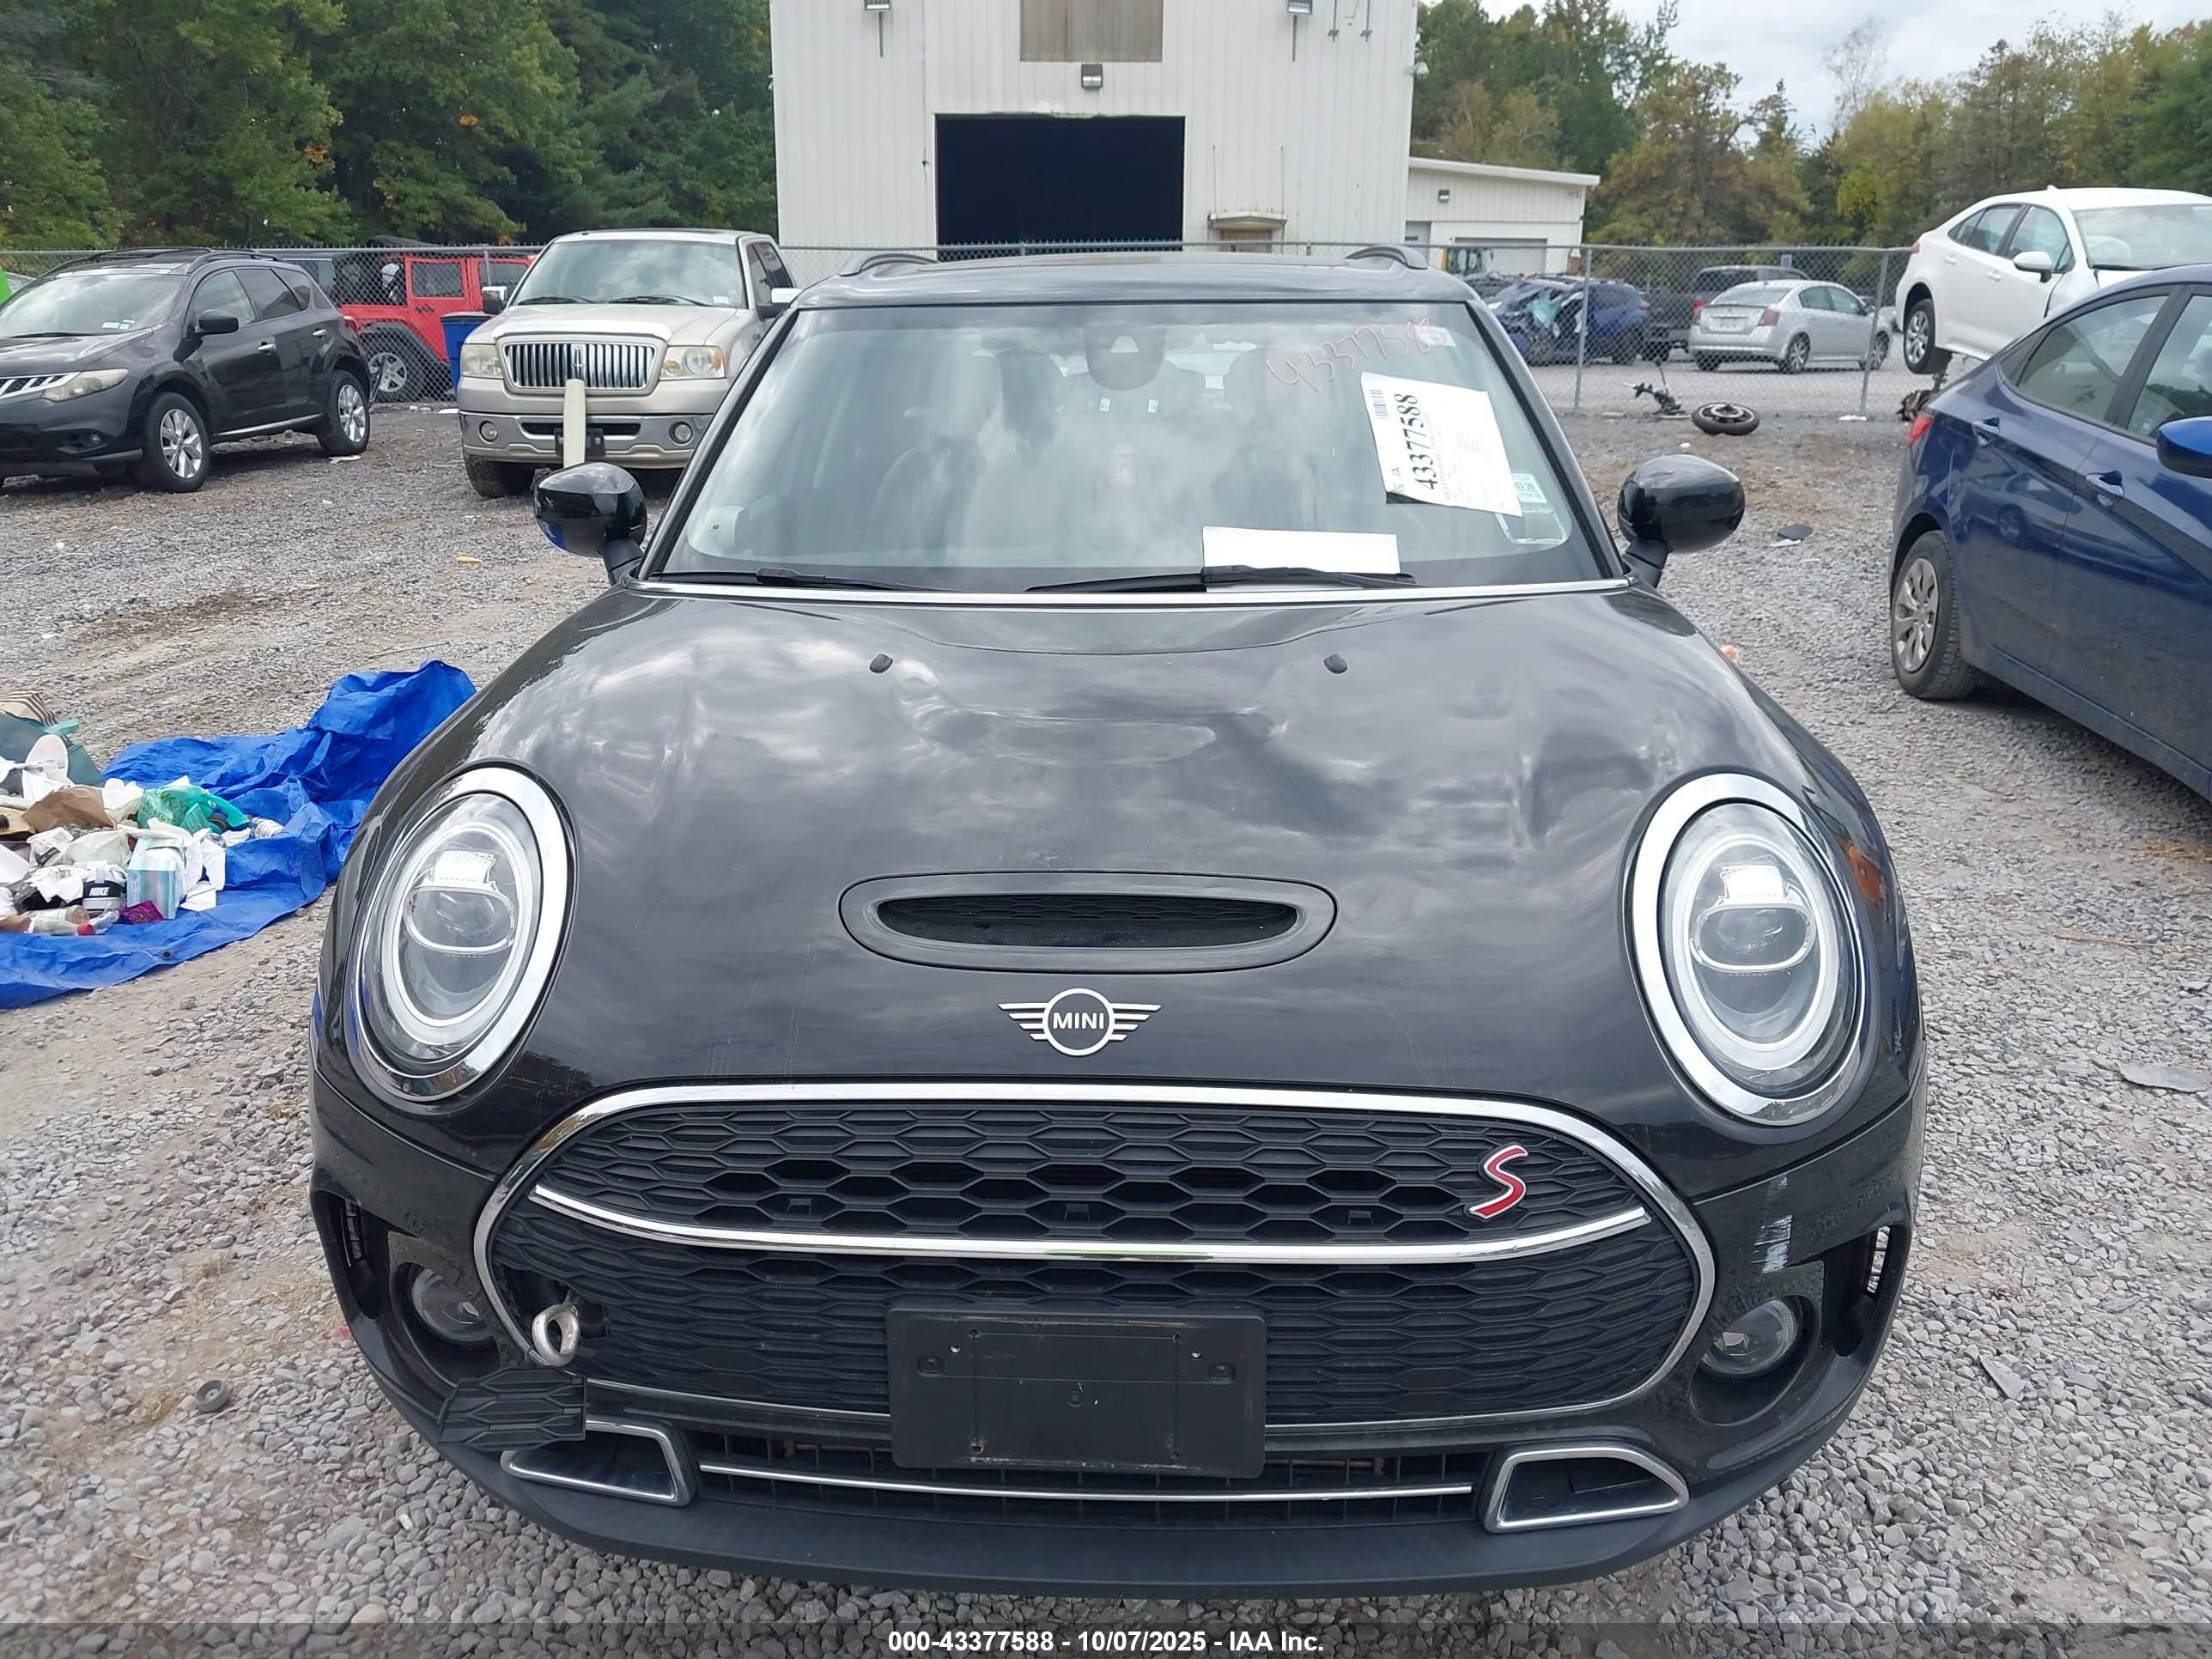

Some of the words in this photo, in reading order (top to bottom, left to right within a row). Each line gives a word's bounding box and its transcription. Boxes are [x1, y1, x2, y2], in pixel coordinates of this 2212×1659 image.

[1394, 393, 1438, 490] 43377588
[88, 886, 110, 896] NIKE
[1053, 1012, 1104, 1030] MINI
[1468, 1144, 1528, 1219] S
